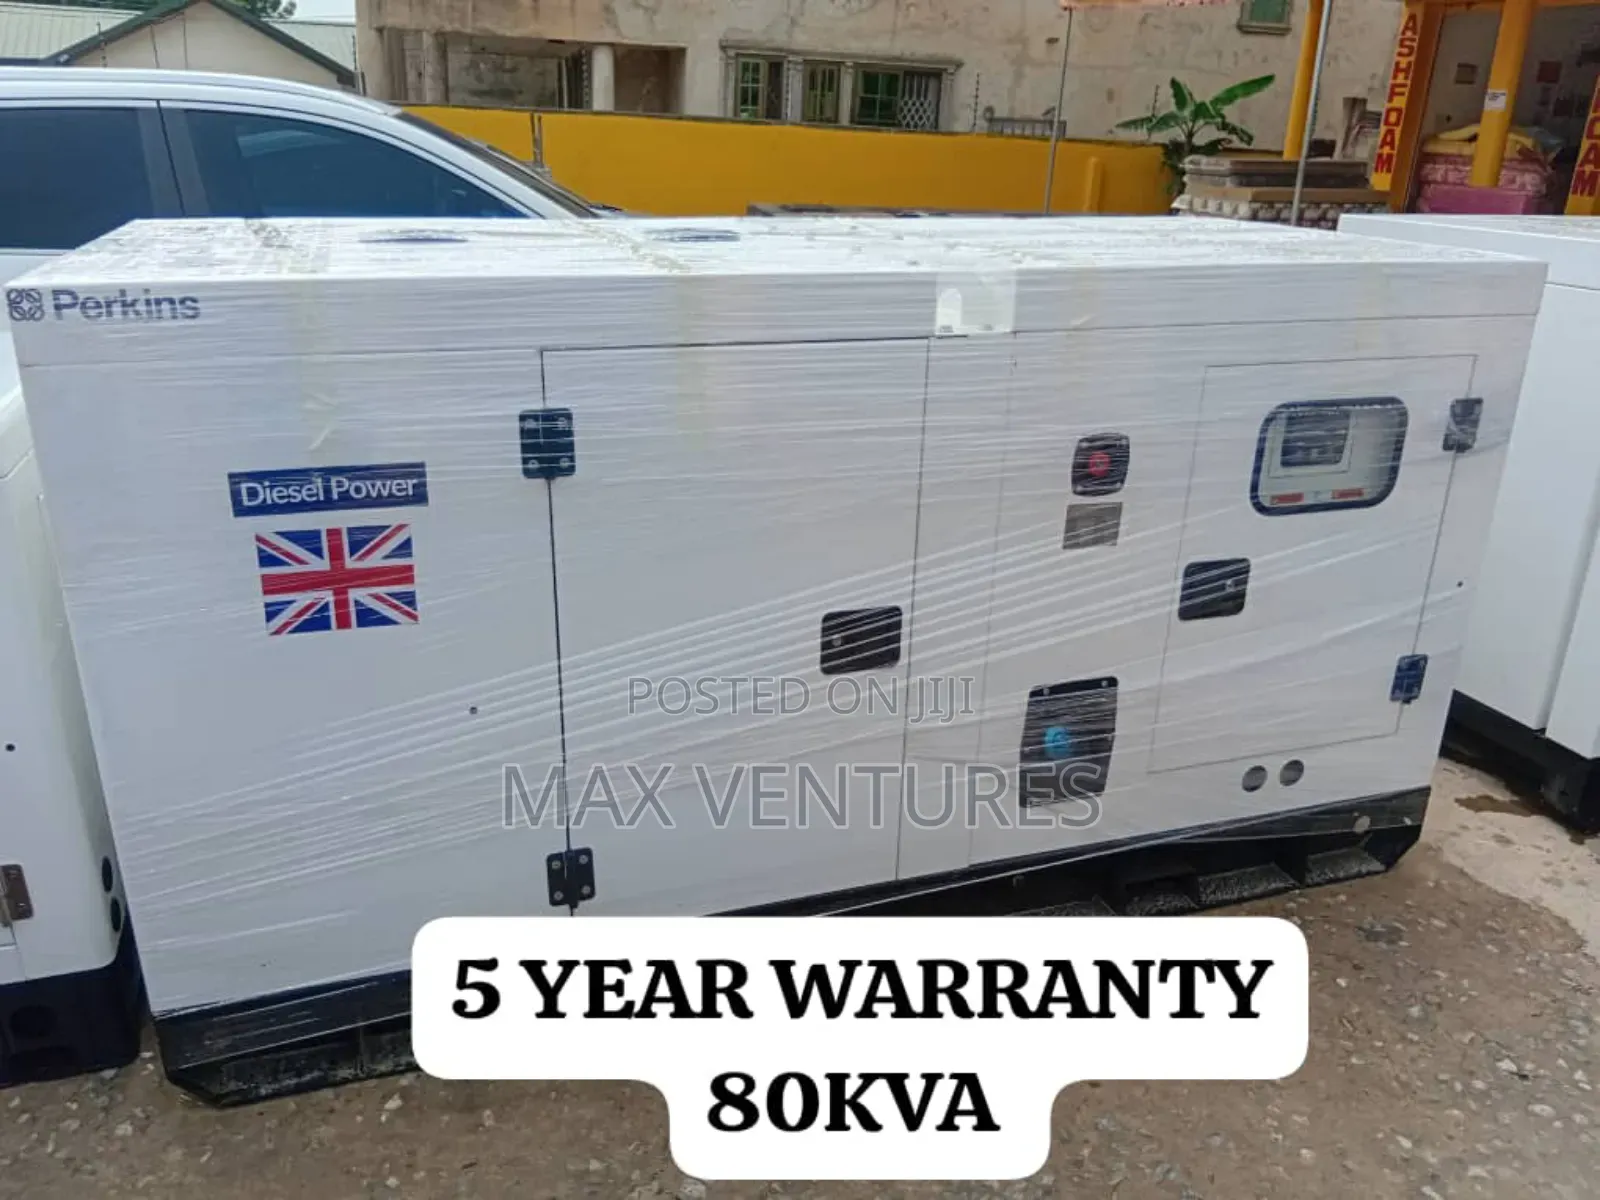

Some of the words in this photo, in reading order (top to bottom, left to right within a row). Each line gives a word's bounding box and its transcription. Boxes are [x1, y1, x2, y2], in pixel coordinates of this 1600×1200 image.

[1373, 12, 1418, 174] ASHFOAM
[52, 288, 201, 320] Perkins
[240, 477, 324, 506] Diesel
[331, 475, 419, 502] Power
